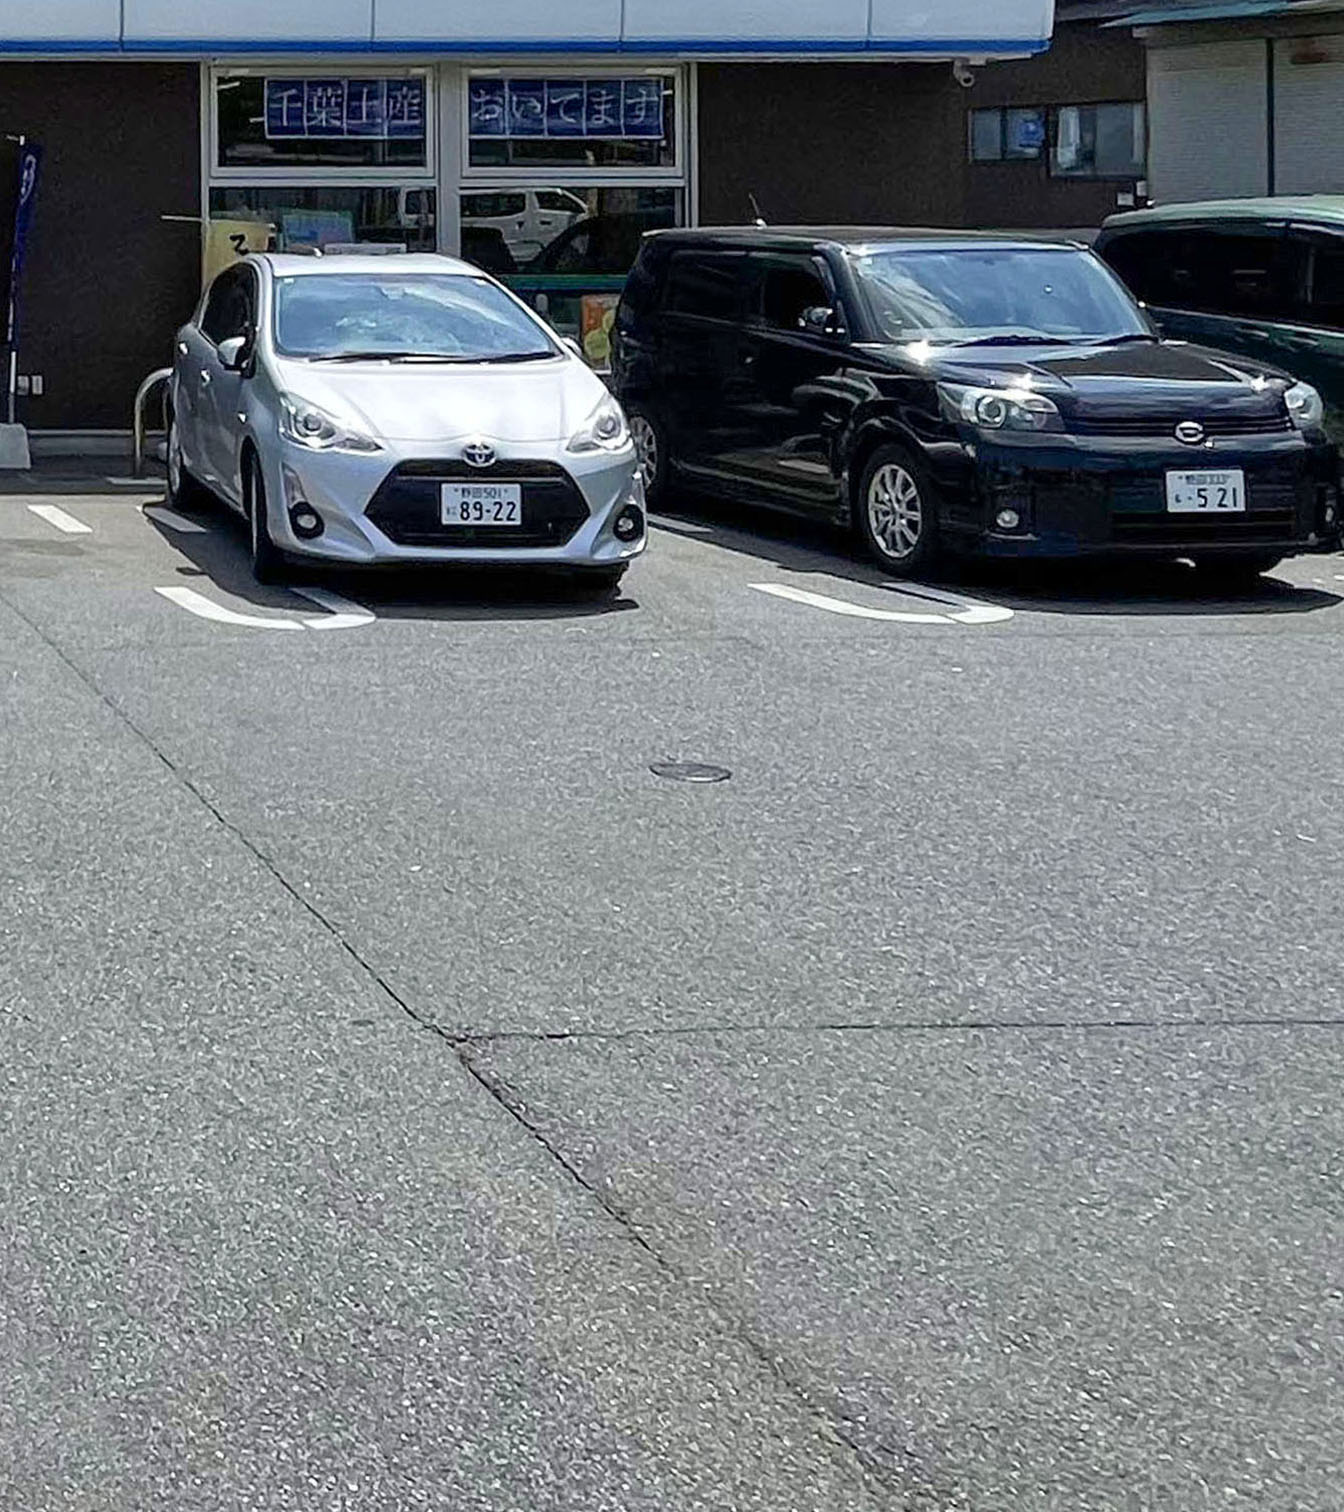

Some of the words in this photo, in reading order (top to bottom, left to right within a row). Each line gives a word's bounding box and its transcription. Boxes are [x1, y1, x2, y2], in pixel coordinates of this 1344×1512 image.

[269, 86, 421, 127] 千葉土産
[472, 88, 659, 125] おいてます
[460, 501, 516, 522] 89-22
